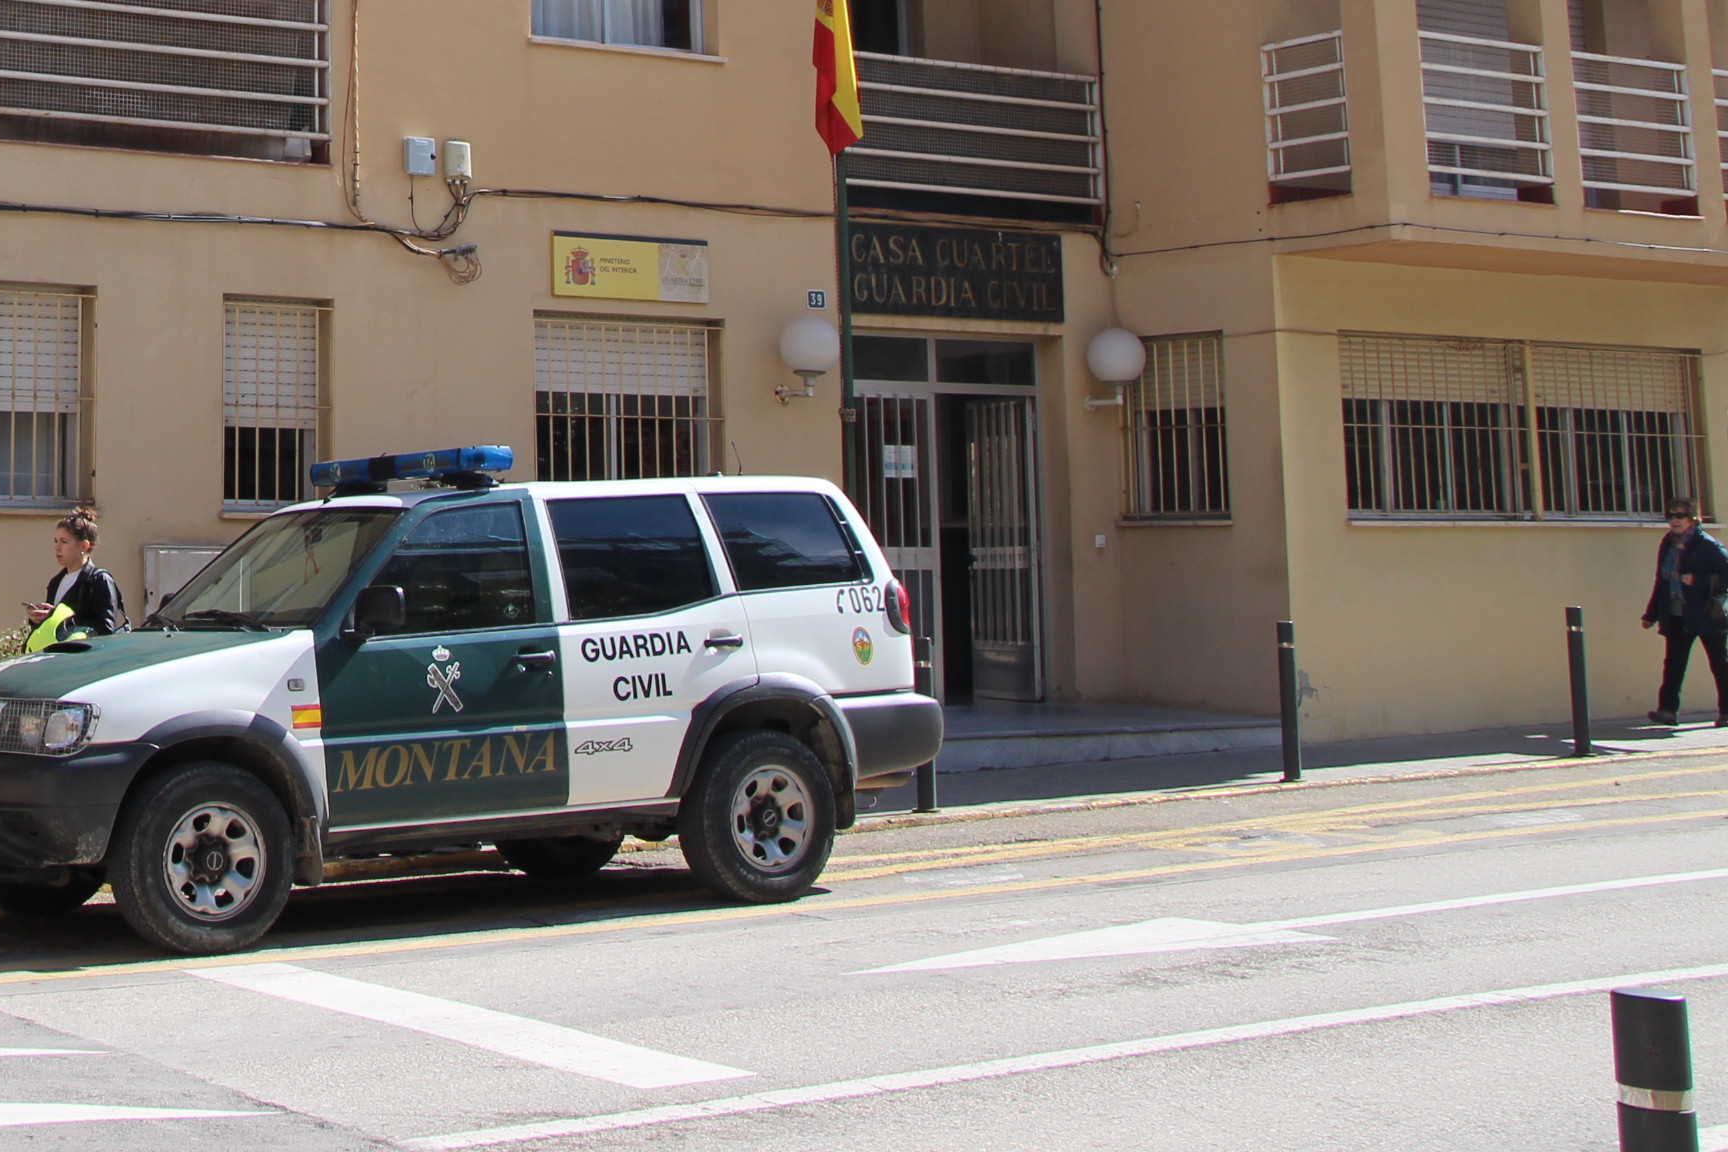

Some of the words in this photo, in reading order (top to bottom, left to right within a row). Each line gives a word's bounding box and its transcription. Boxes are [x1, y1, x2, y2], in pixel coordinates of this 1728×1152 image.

[599, 257, 631, 266] MINISTERIO
[852, 233, 924, 265] CASA
[936, 239, 1055, 273] CUARTEL
[599, 265, 611, 273] DEL
[612, 266, 638, 274] INTERIOR
[810, 293, 823, 306] 39
[854, 273, 976, 307] GUARDIA
[986, 279, 1056, 311] CIVIL
[848, 585, 885, 614] 062
[581, 630, 692, 663] GUARDIA
[613, 672, 673, 701] CIVIL
[574, 737, 633, 756] 4x4
